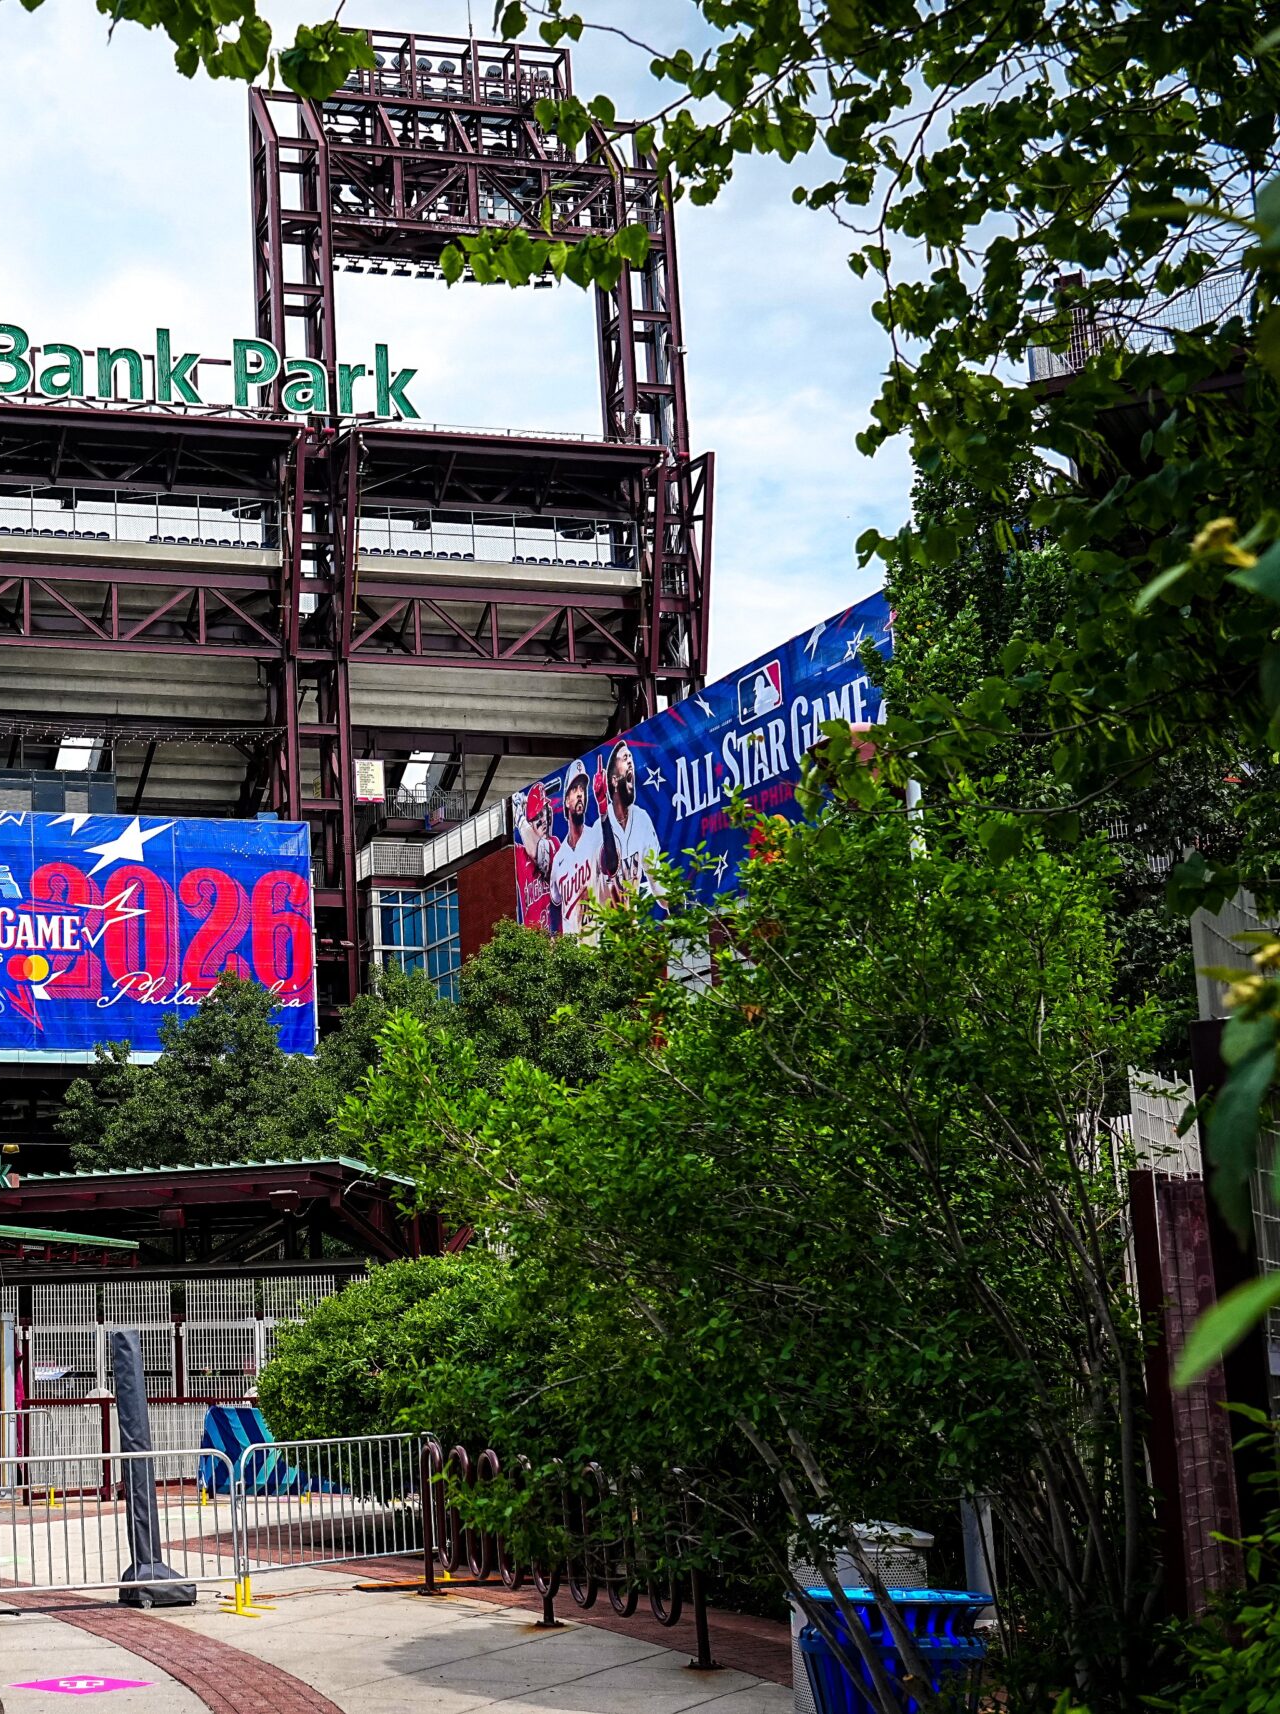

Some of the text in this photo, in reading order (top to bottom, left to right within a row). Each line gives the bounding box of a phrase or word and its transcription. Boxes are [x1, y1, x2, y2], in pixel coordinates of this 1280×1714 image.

[232, 338, 421, 419] Park
[672, 751, 721, 822] ALL
[722, 718, 790, 797] STAR
[29, 862, 314, 1000] 2026
